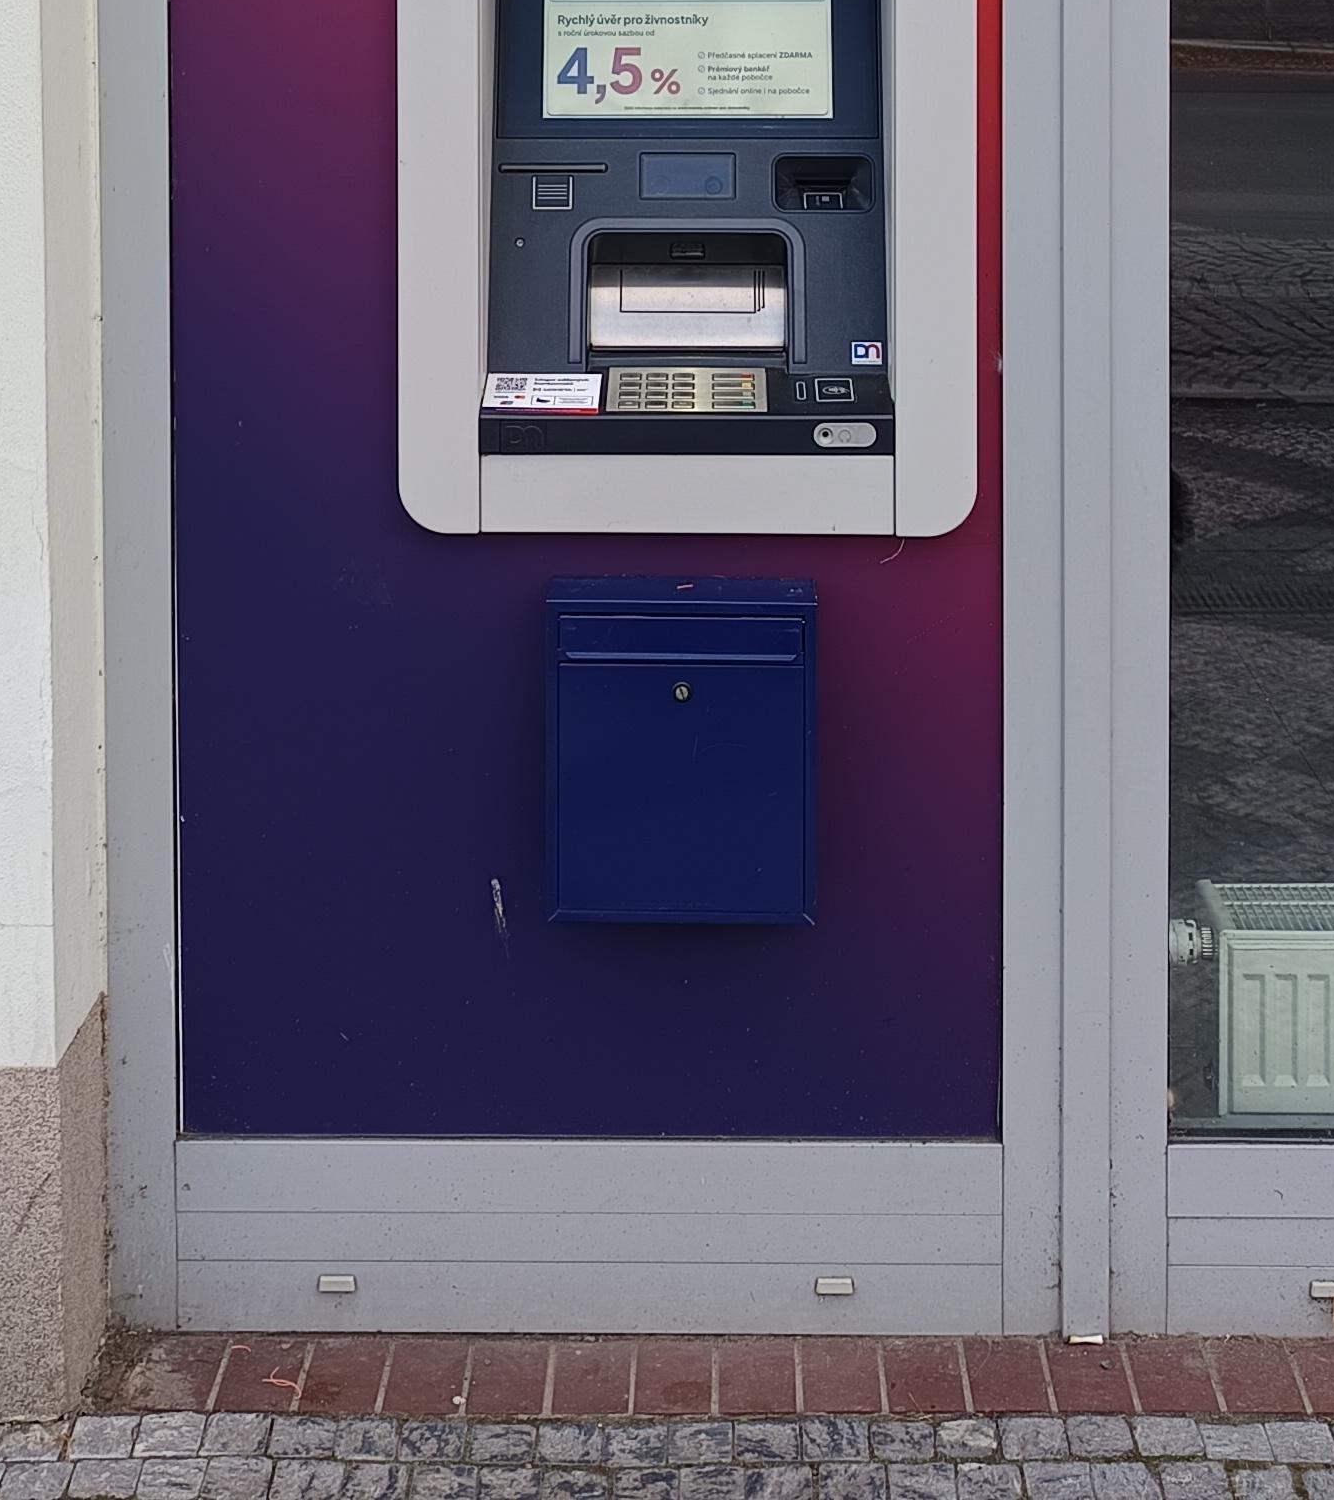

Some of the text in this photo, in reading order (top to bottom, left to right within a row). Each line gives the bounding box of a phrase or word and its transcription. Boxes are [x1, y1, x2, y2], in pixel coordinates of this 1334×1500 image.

[557, 13, 709, 28] Rychlý úvěr pro živnostníky
[778, 51, 813, 59] ZDARMA
[555, 45, 682, 106] 4,5 %
